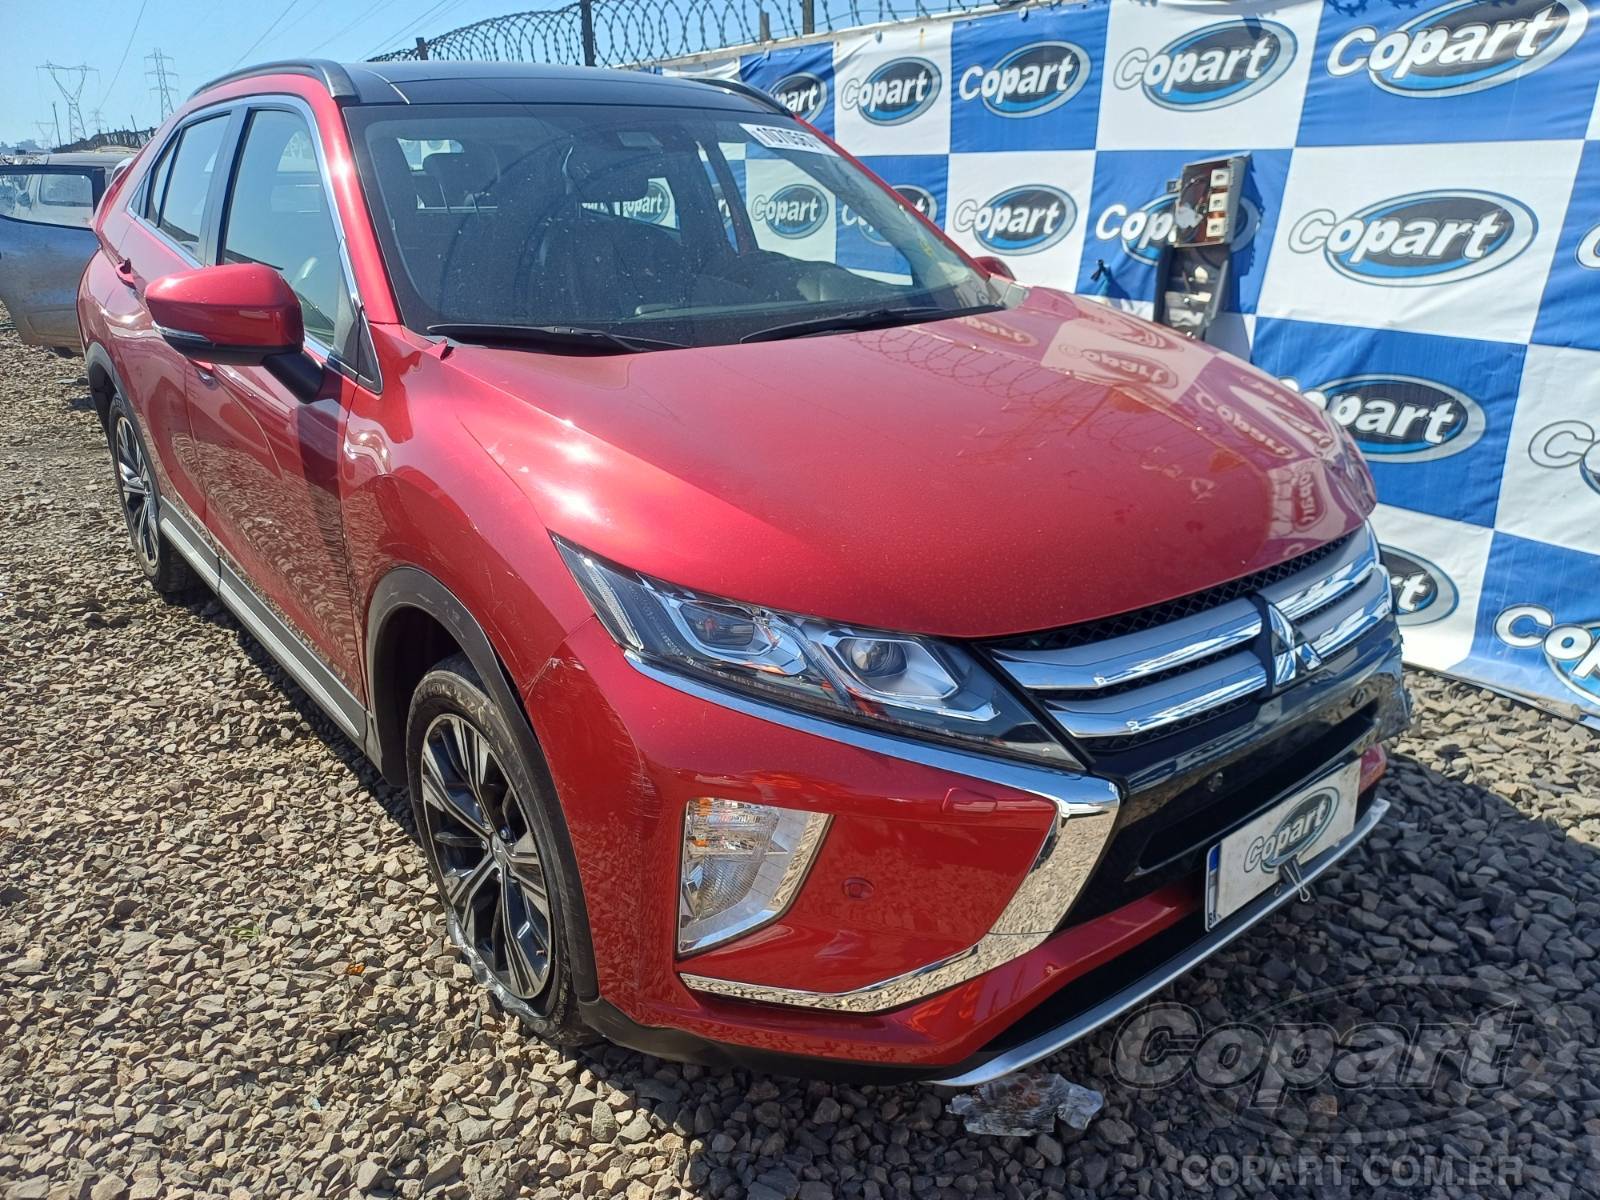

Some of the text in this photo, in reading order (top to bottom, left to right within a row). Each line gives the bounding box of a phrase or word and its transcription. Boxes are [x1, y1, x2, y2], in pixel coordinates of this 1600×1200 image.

[1113, 33, 1274, 95] Copart
[1326, 5, 1558, 80] Copart
[768, 83, 818, 112] part
[841, 69, 929, 111] Copart
[959, 53, 1075, 105] Copart
[752, 196, 818, 223] Copart
[953, 199, 1060, 238] Copart
[1096, 203, 1177, 249] Cop
[1288, 210, 1504, 263] Copart
[1244, 797, 1327, 873] Copart
